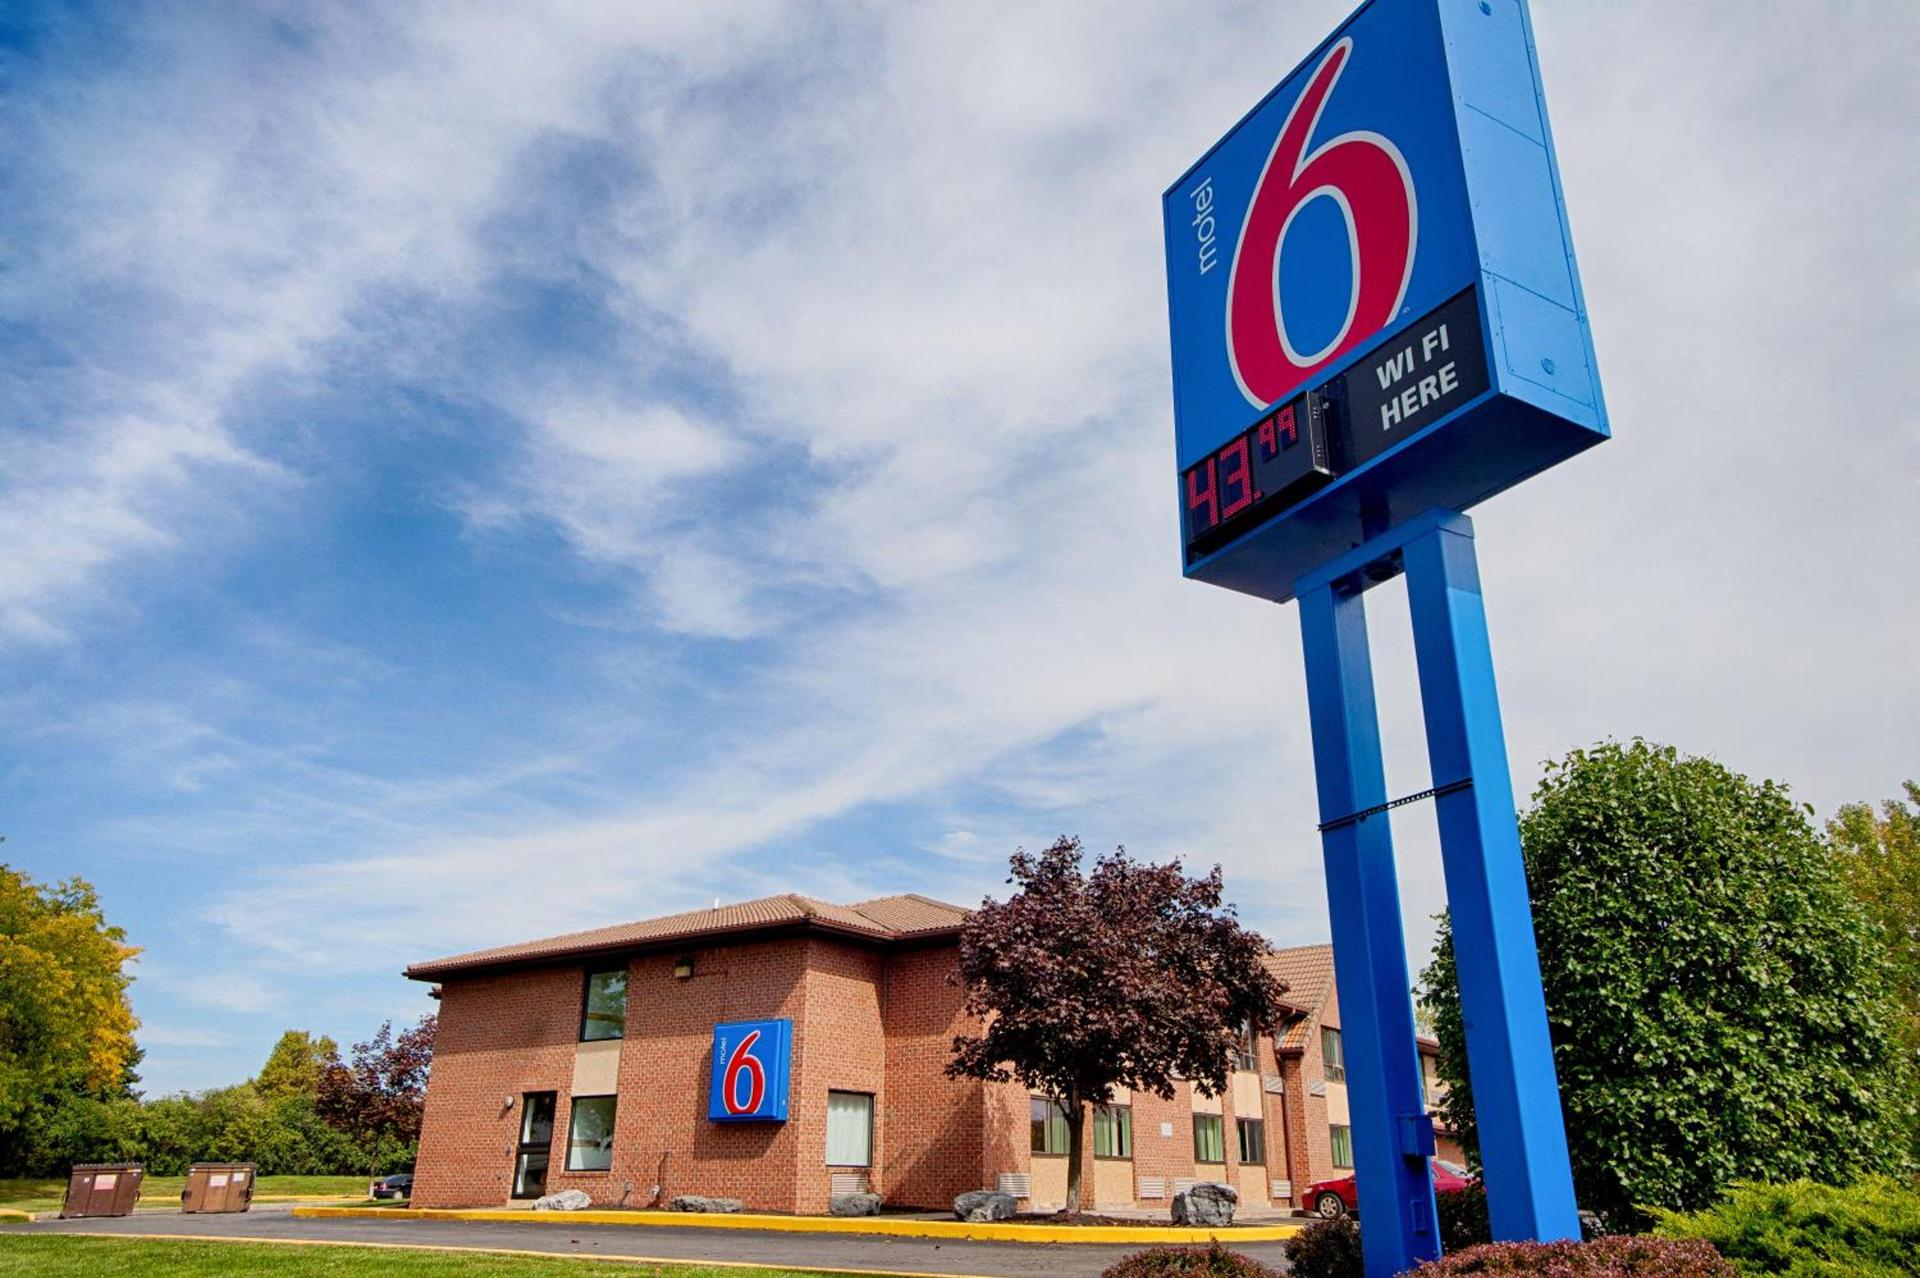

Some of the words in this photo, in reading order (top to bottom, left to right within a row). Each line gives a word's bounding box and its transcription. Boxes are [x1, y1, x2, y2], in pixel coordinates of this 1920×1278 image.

[1190, 176, 1217, 275] motel
[1225, 36, 1418, 411] 6
[1376, 346, 1415, 390] WI
[1422, 323, 1450, 362] FI
[1380, 361, 1459, 431] HERE
[723, 1030, 766, 1115] 6
